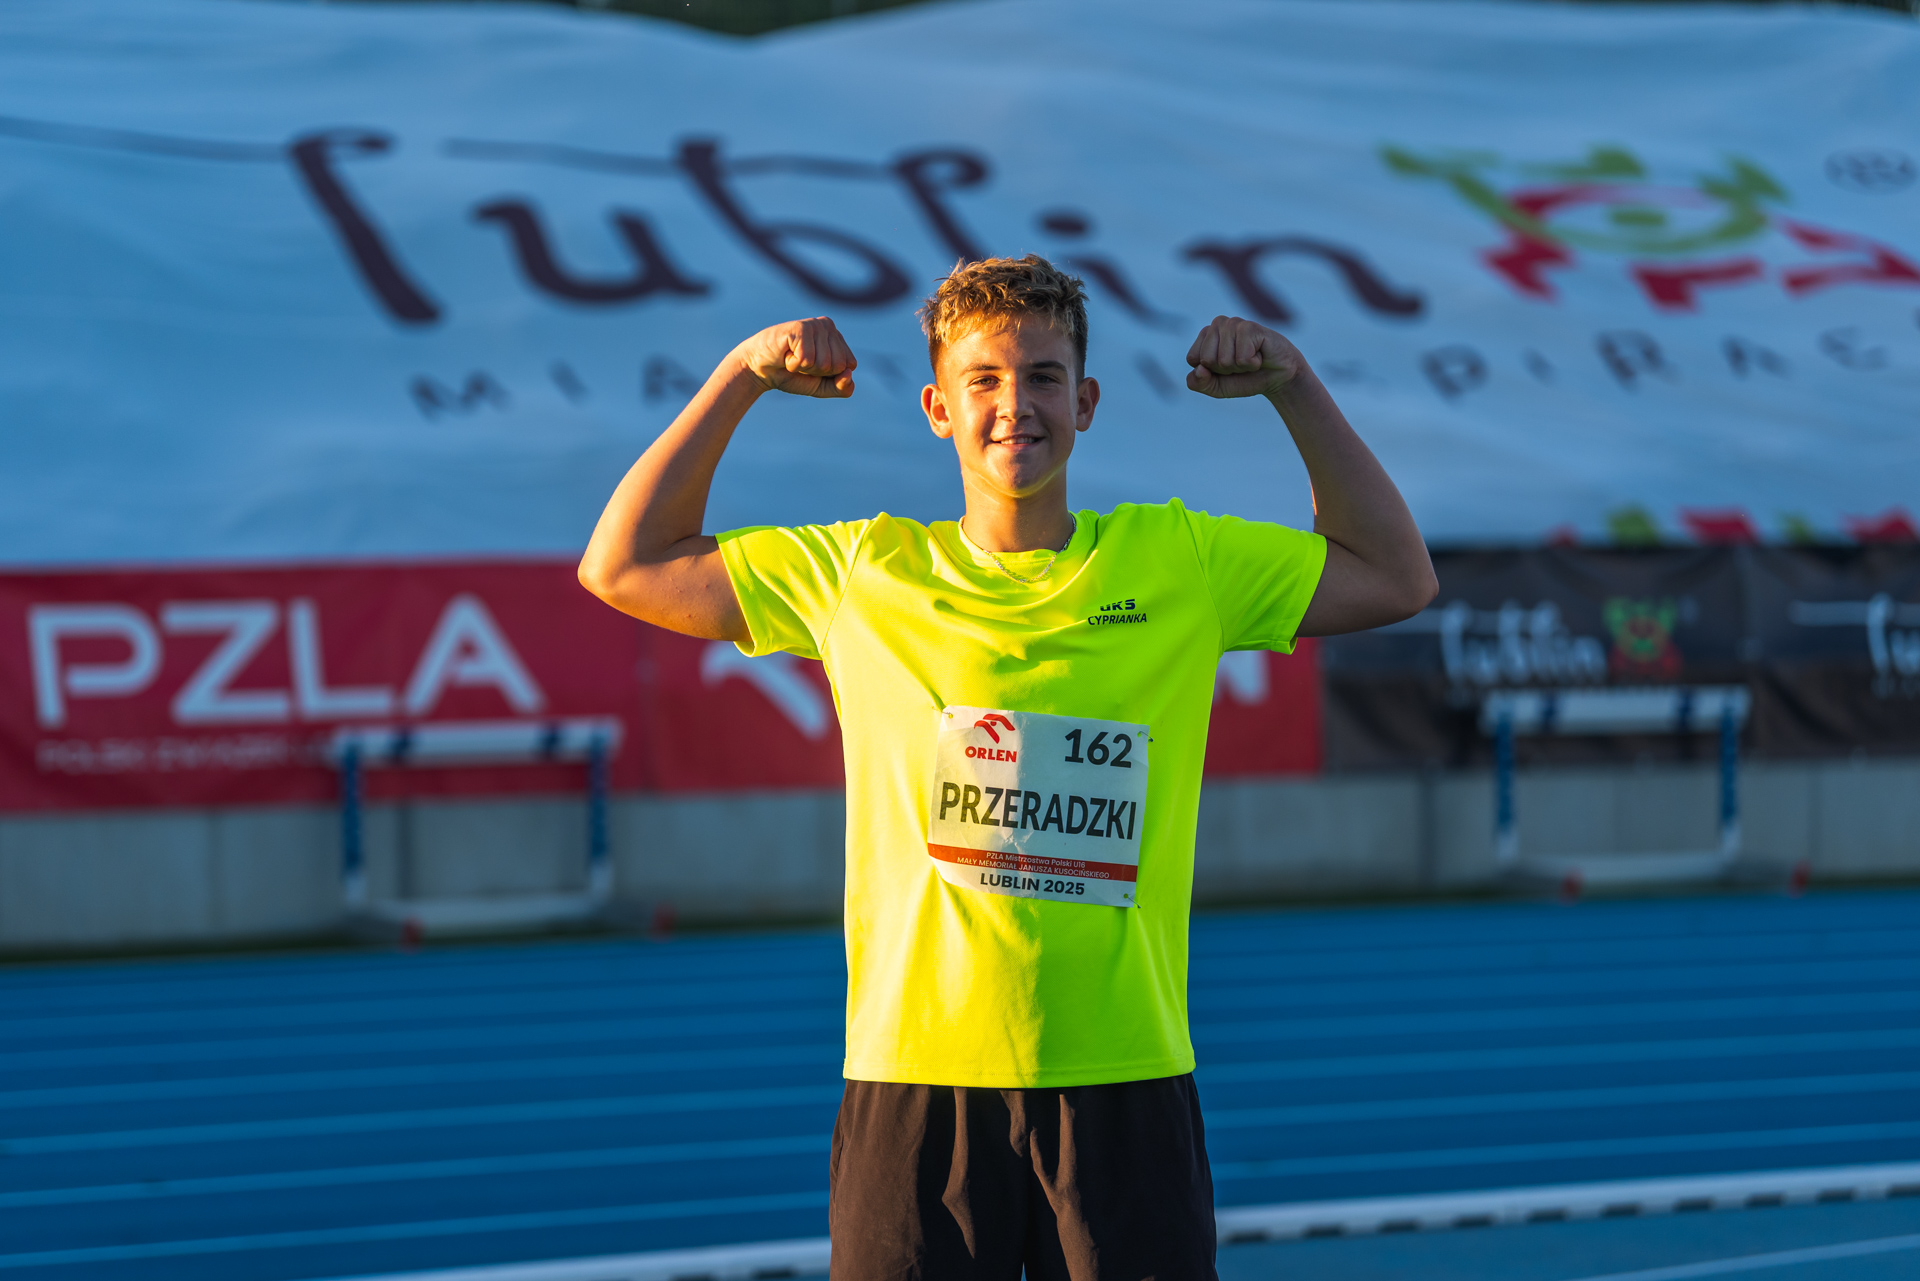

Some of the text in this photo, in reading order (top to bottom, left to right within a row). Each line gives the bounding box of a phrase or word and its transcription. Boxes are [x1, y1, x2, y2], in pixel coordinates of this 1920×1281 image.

[1100, 598, 1136, 612] UKS
[1087, 613, 1148, 626] CYPRIANKA
[27, 592, 548, 730] PZLA
[965, 746, 1018, 763] ORLEN
[1064, 728, 1133, 769] 162
[939, 781, 1137, 841] PRZERADZKI
[957, 856, 1110, 879] MAŁY MEMORIAŁ JANUSZA KUSOCIŃSKIEGO
[986, 852, 1086, 869] PZLA Mistrzostwa Polski U16
[980, 873, 1086, 896] LUBLIN 2025
